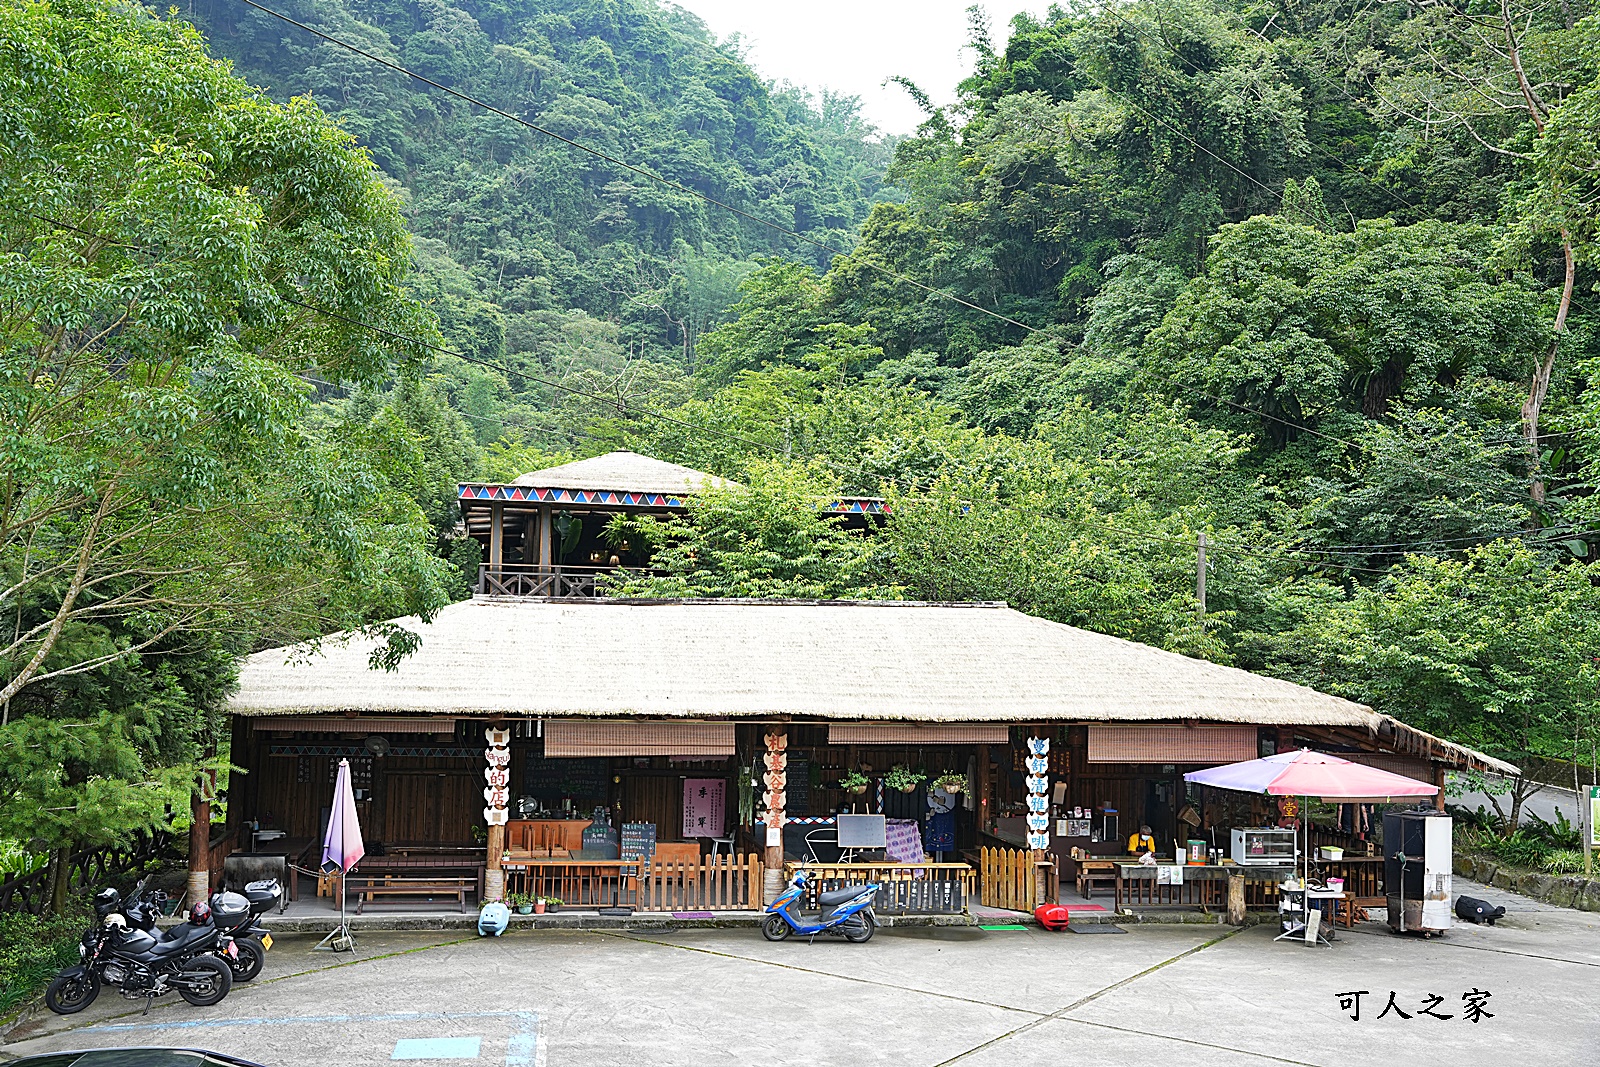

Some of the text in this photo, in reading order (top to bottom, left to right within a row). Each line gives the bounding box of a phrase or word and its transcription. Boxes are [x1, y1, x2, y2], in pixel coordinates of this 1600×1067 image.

[489, 771, 505, 806] 的店
[768, 735, 785, 829] 札基谷農產
[1031, 739, 1048, 849] 曼舒清雅咖啡
